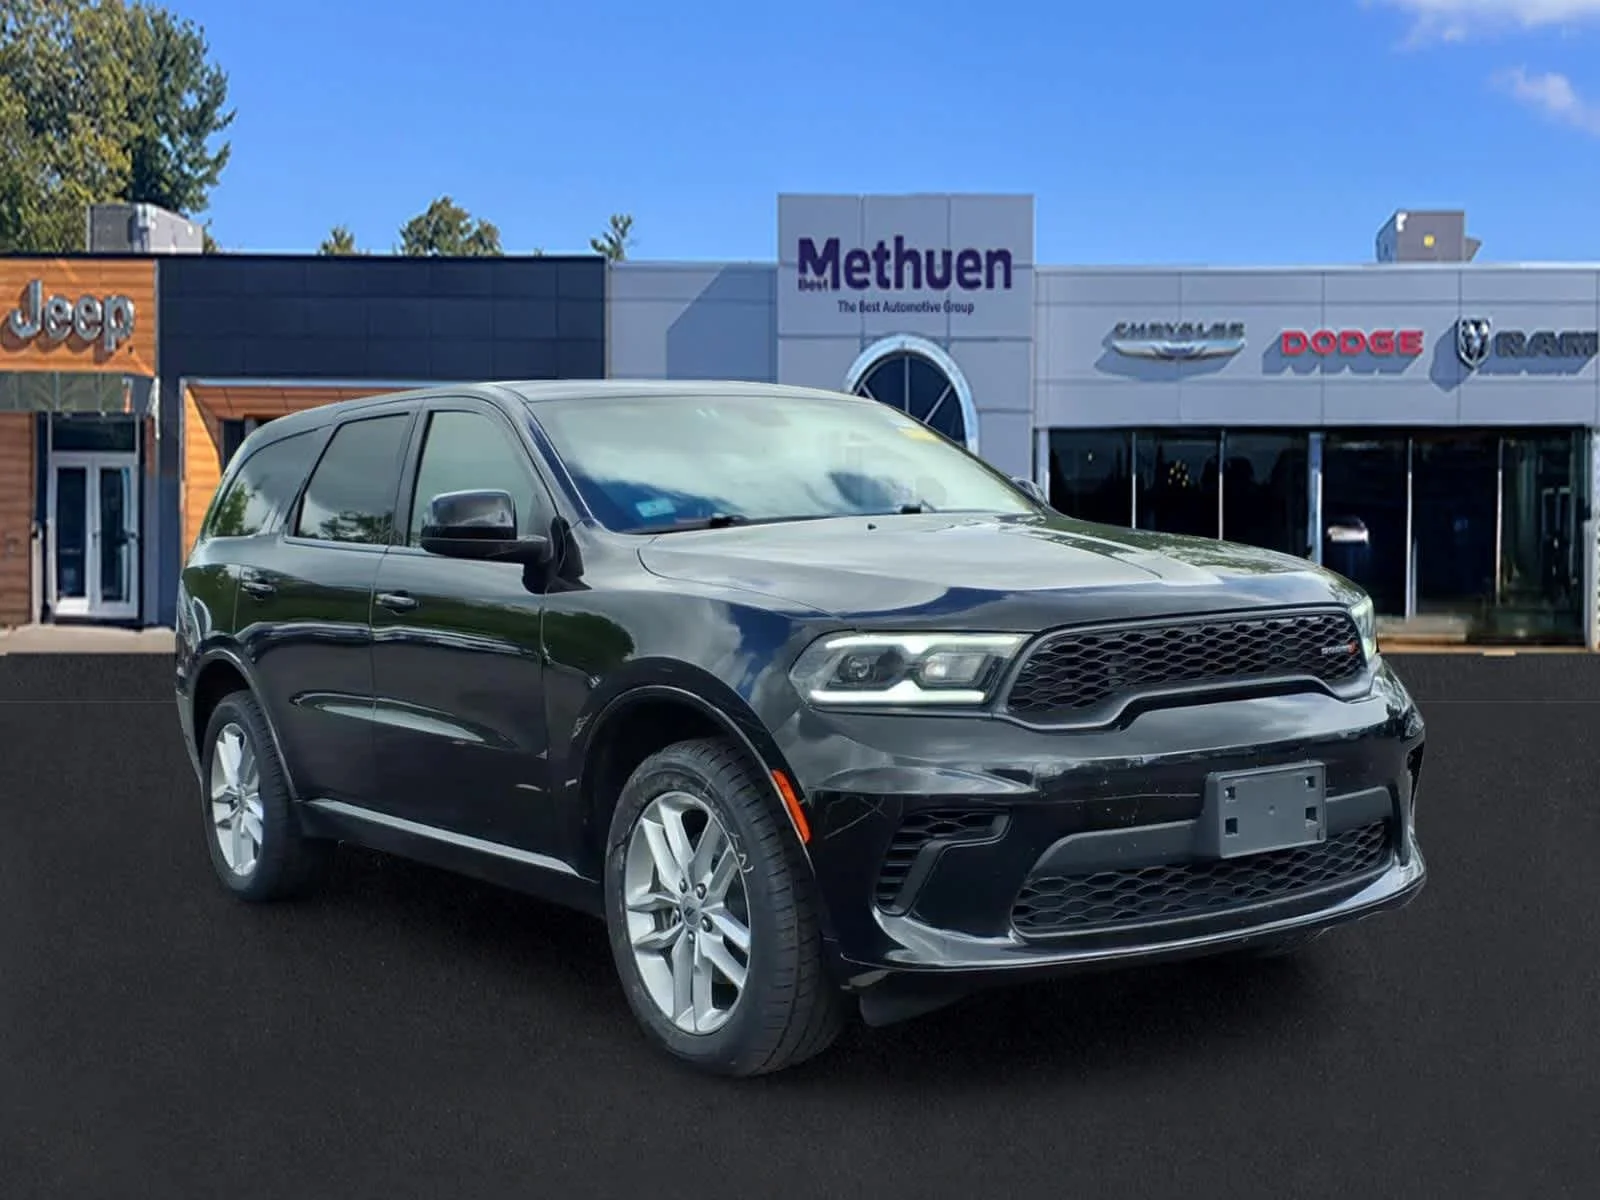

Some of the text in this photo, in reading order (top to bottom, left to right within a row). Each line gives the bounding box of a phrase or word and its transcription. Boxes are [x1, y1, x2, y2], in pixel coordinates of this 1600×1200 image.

[797, 235, 1012, 290] Methuen
[9, 279, 135, 352] Jeep
[838, 300, 975, 316] The Best Automotive Group
[1281, 330, 1424, 355] DODGE
[1495, 331, 1598, 358] RAM
